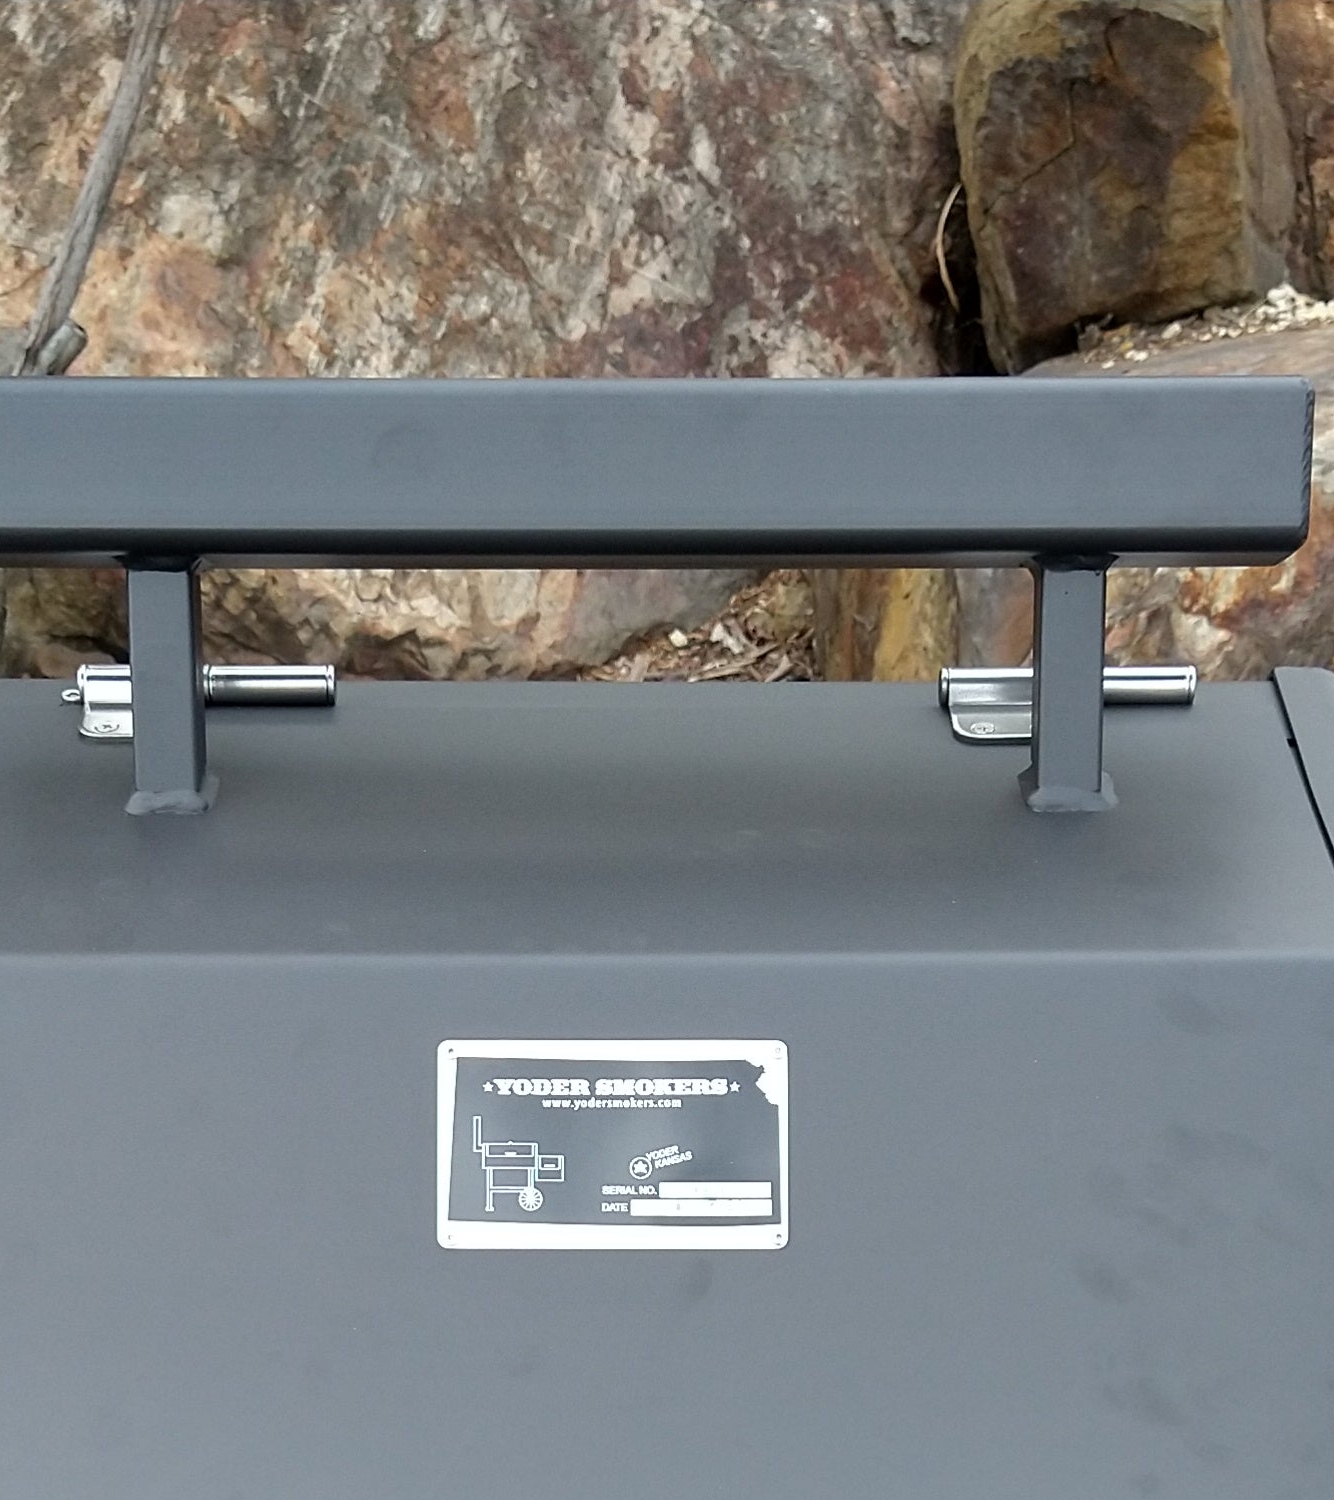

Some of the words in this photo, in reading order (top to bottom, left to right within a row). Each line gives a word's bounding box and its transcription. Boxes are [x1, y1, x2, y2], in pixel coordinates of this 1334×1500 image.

[492, 1078, 592, 1096] YODER
[595, 1078, 729, 1096] SMOKERS
[542, 1097, 683, 1110] www.yodersmokers.com
[646, 1146, 680, 1161] YODER
[655, 1152, 693, 1168] KANSAS
[601, 1185, 638, 1196] SERIAL
[639, 1185, 658, 1196] NO.
[601, 1202, 629, 1213] DATE
